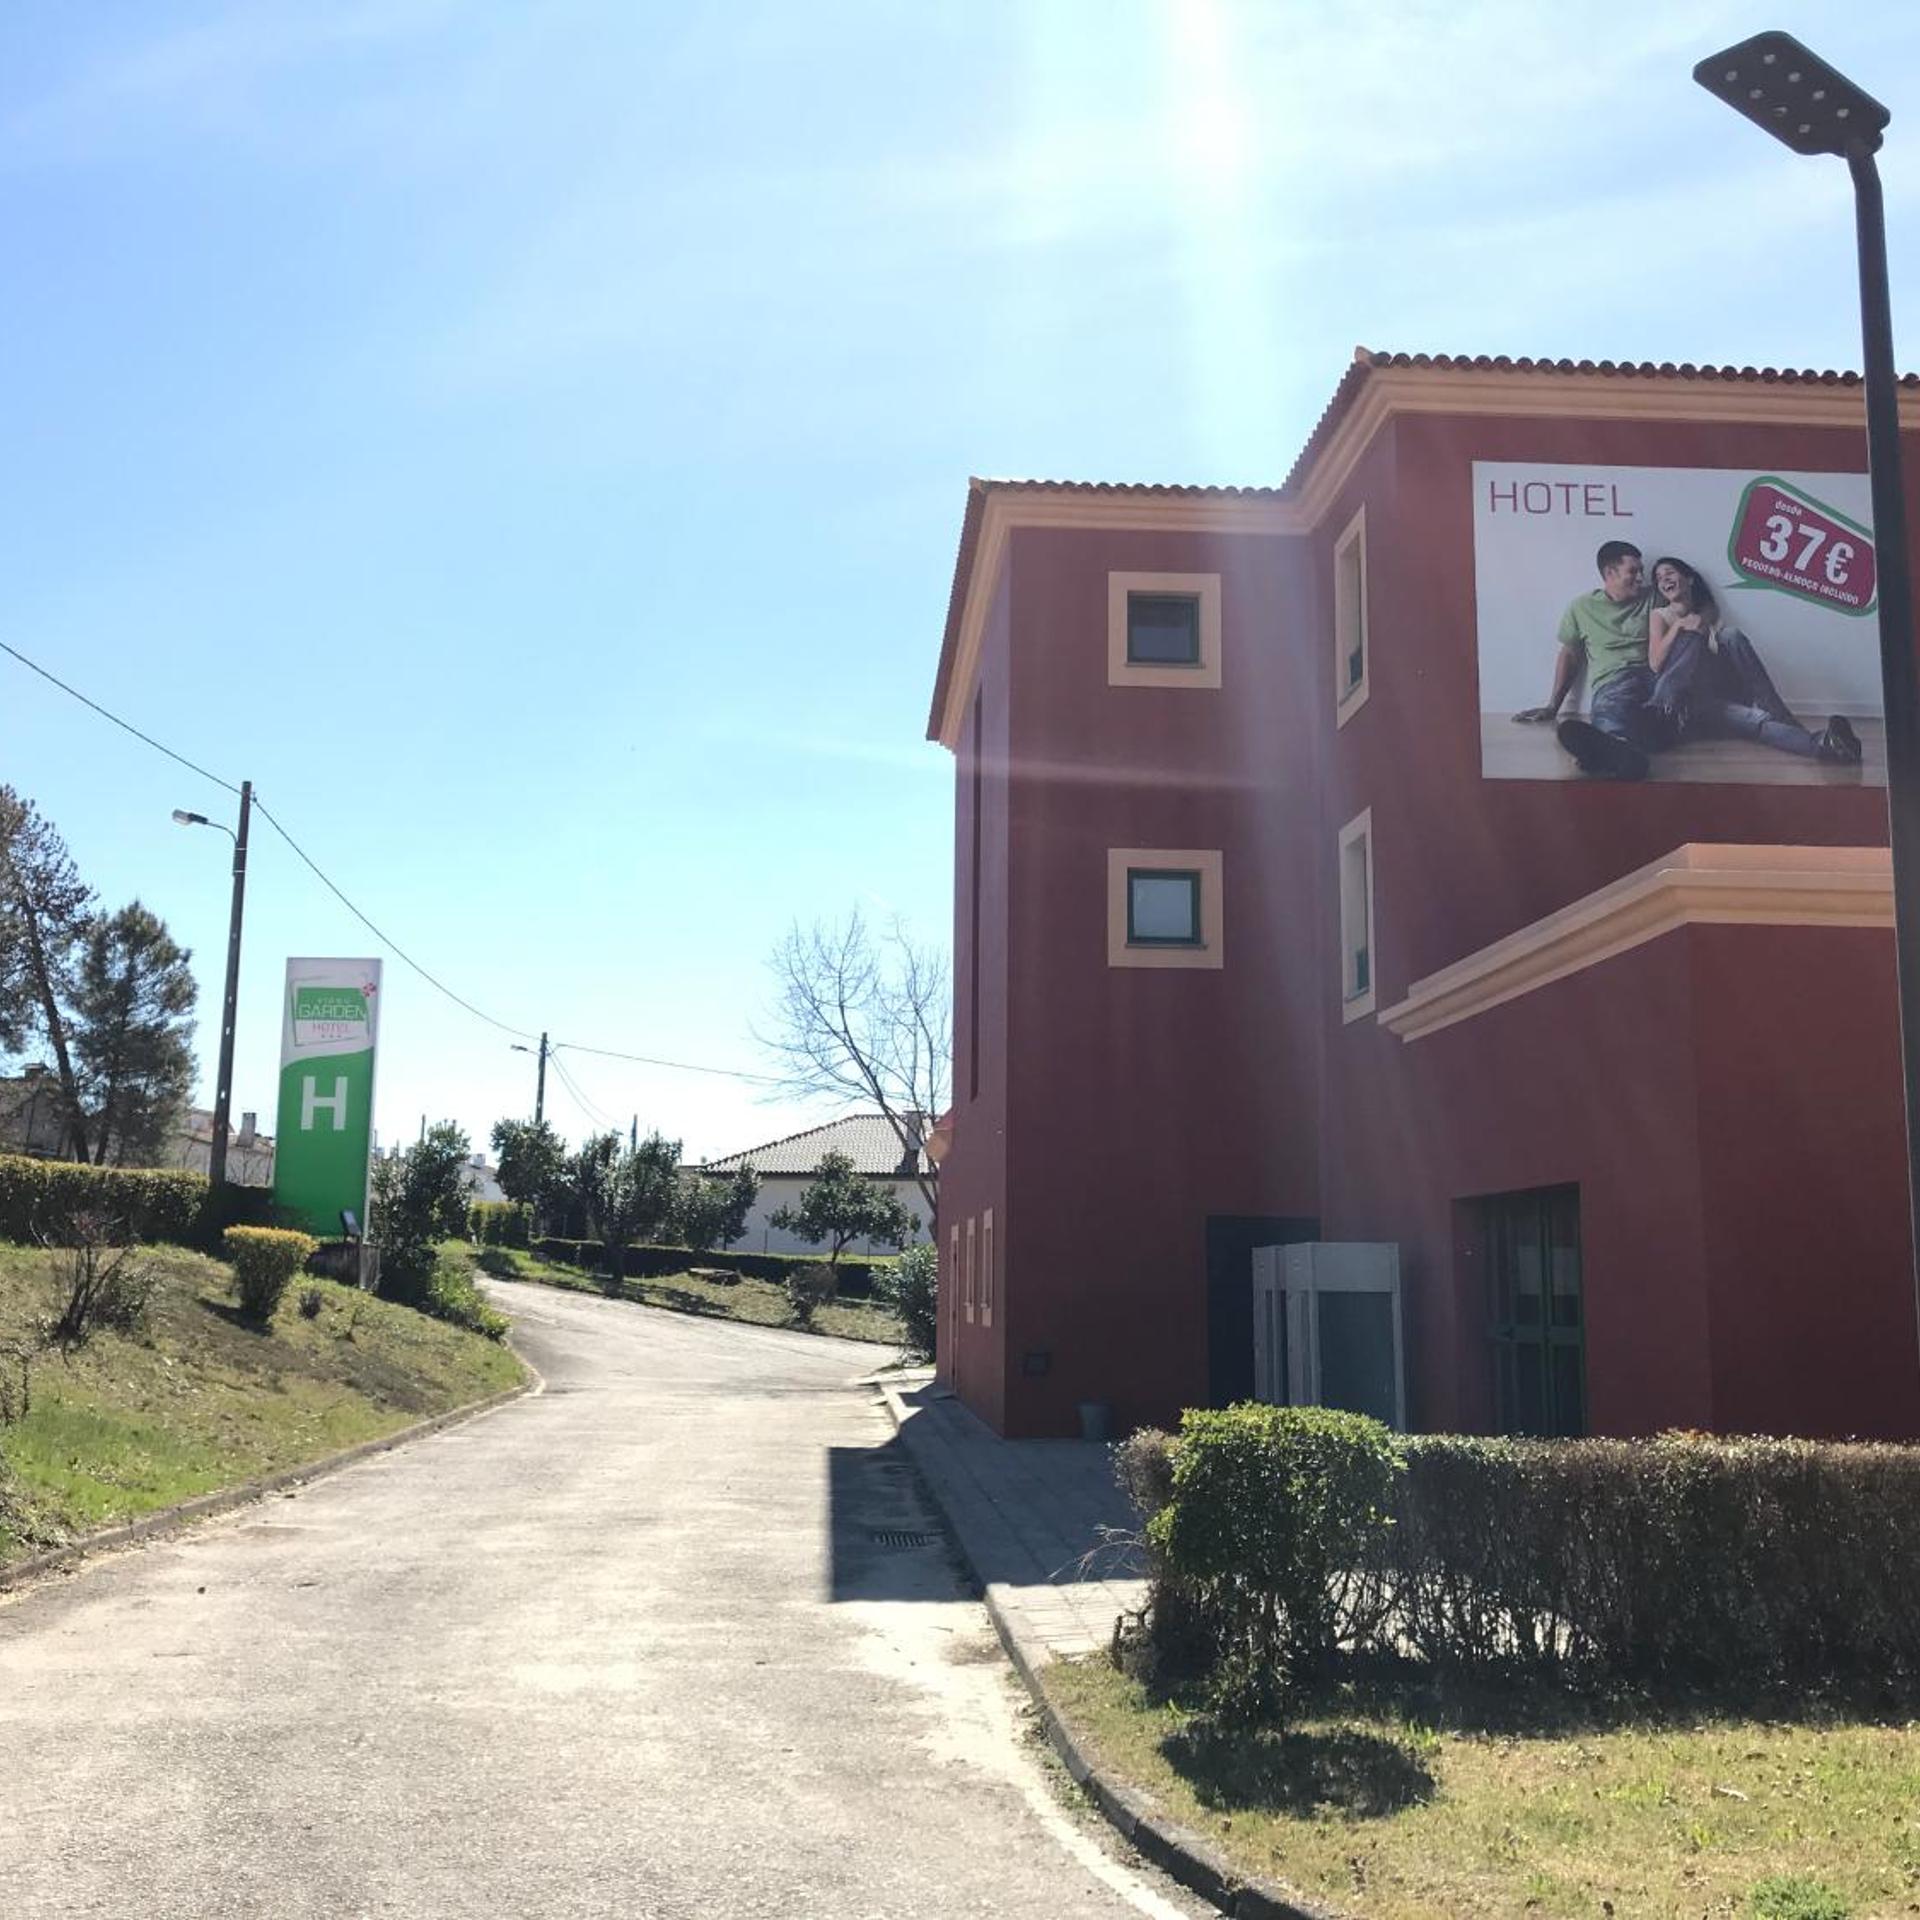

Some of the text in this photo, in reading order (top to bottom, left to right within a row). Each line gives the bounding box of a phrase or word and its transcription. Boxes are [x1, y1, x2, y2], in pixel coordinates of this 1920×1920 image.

[1490, 481, 1633, 516] HOTEL
[1775, 500, 1803, 516] desde
[1759, 514, 1855, 585] 37€
[300, 1004, 366, 1018] GARDEN
[312, 1022, 351, 1033] HOTEL
[301, 1076, 348, 1130] H
